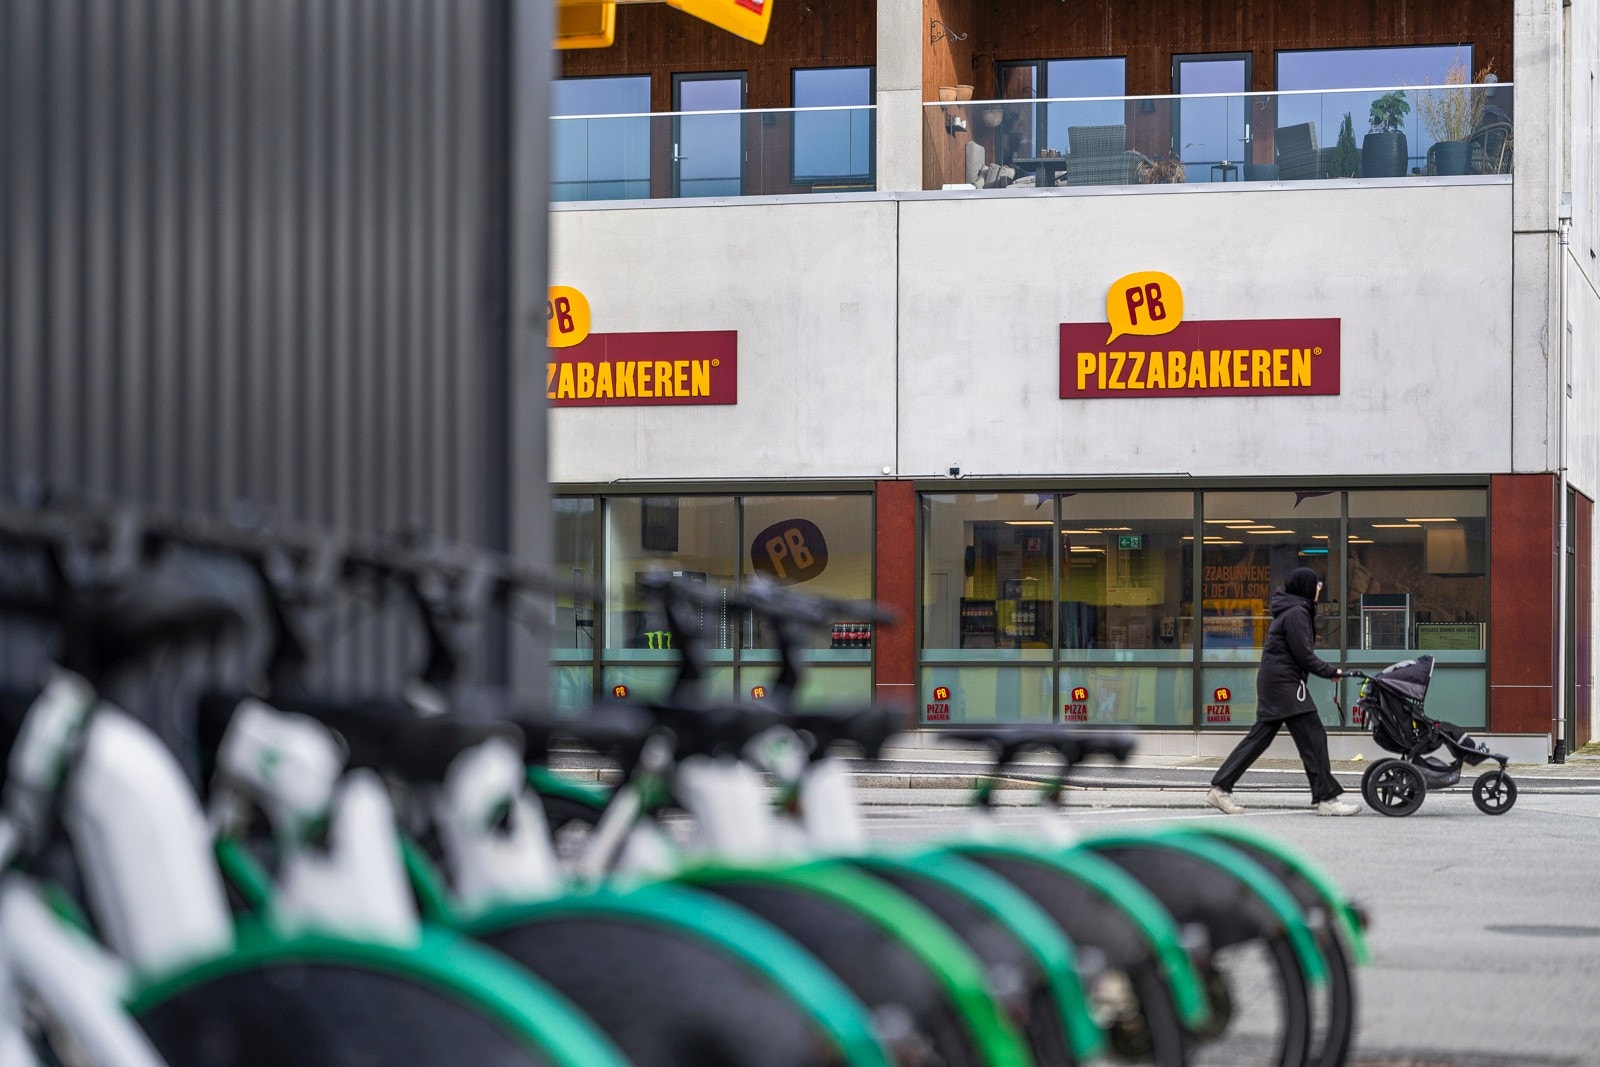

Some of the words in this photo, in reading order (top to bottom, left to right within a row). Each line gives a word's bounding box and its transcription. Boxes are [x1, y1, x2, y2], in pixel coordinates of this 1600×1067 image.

[1125, 282, 1167, 326] PB
[766, 528, 814, 578] PB
[1247, 583, 1269, 598] SOM
[936, 688, 947, 699] PB
[1075, 688, 1085, 699] PB
[1217, 689, 1228, 700] PB
[927, 704, 949, 713] PIZZA
[1064, 704, 1087, 714] PIZZA
[1207, 705, 1230, 715] PIZZA
